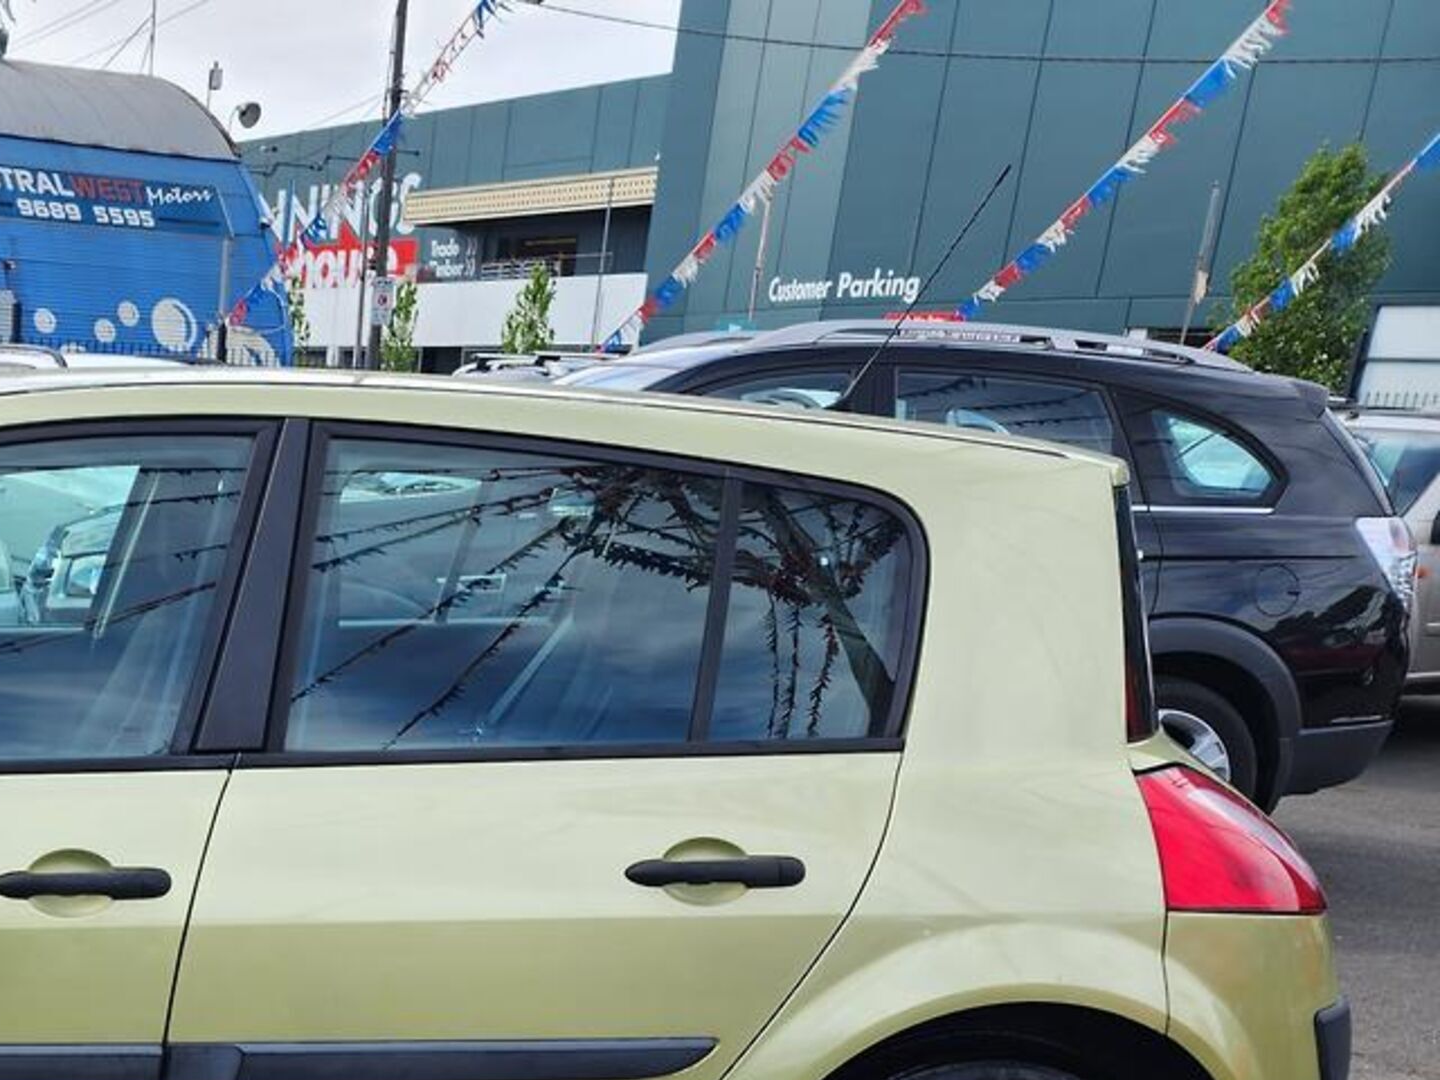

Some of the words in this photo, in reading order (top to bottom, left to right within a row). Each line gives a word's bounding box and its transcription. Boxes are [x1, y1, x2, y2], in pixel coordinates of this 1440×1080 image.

[146, 184, 214, 207] Motors
[15, 198, 82, 221] 9689
[92, 206, 156, 228] 5595
[768, 276, 833, 302] Customer
[836, 266, 921, 304] Parking
